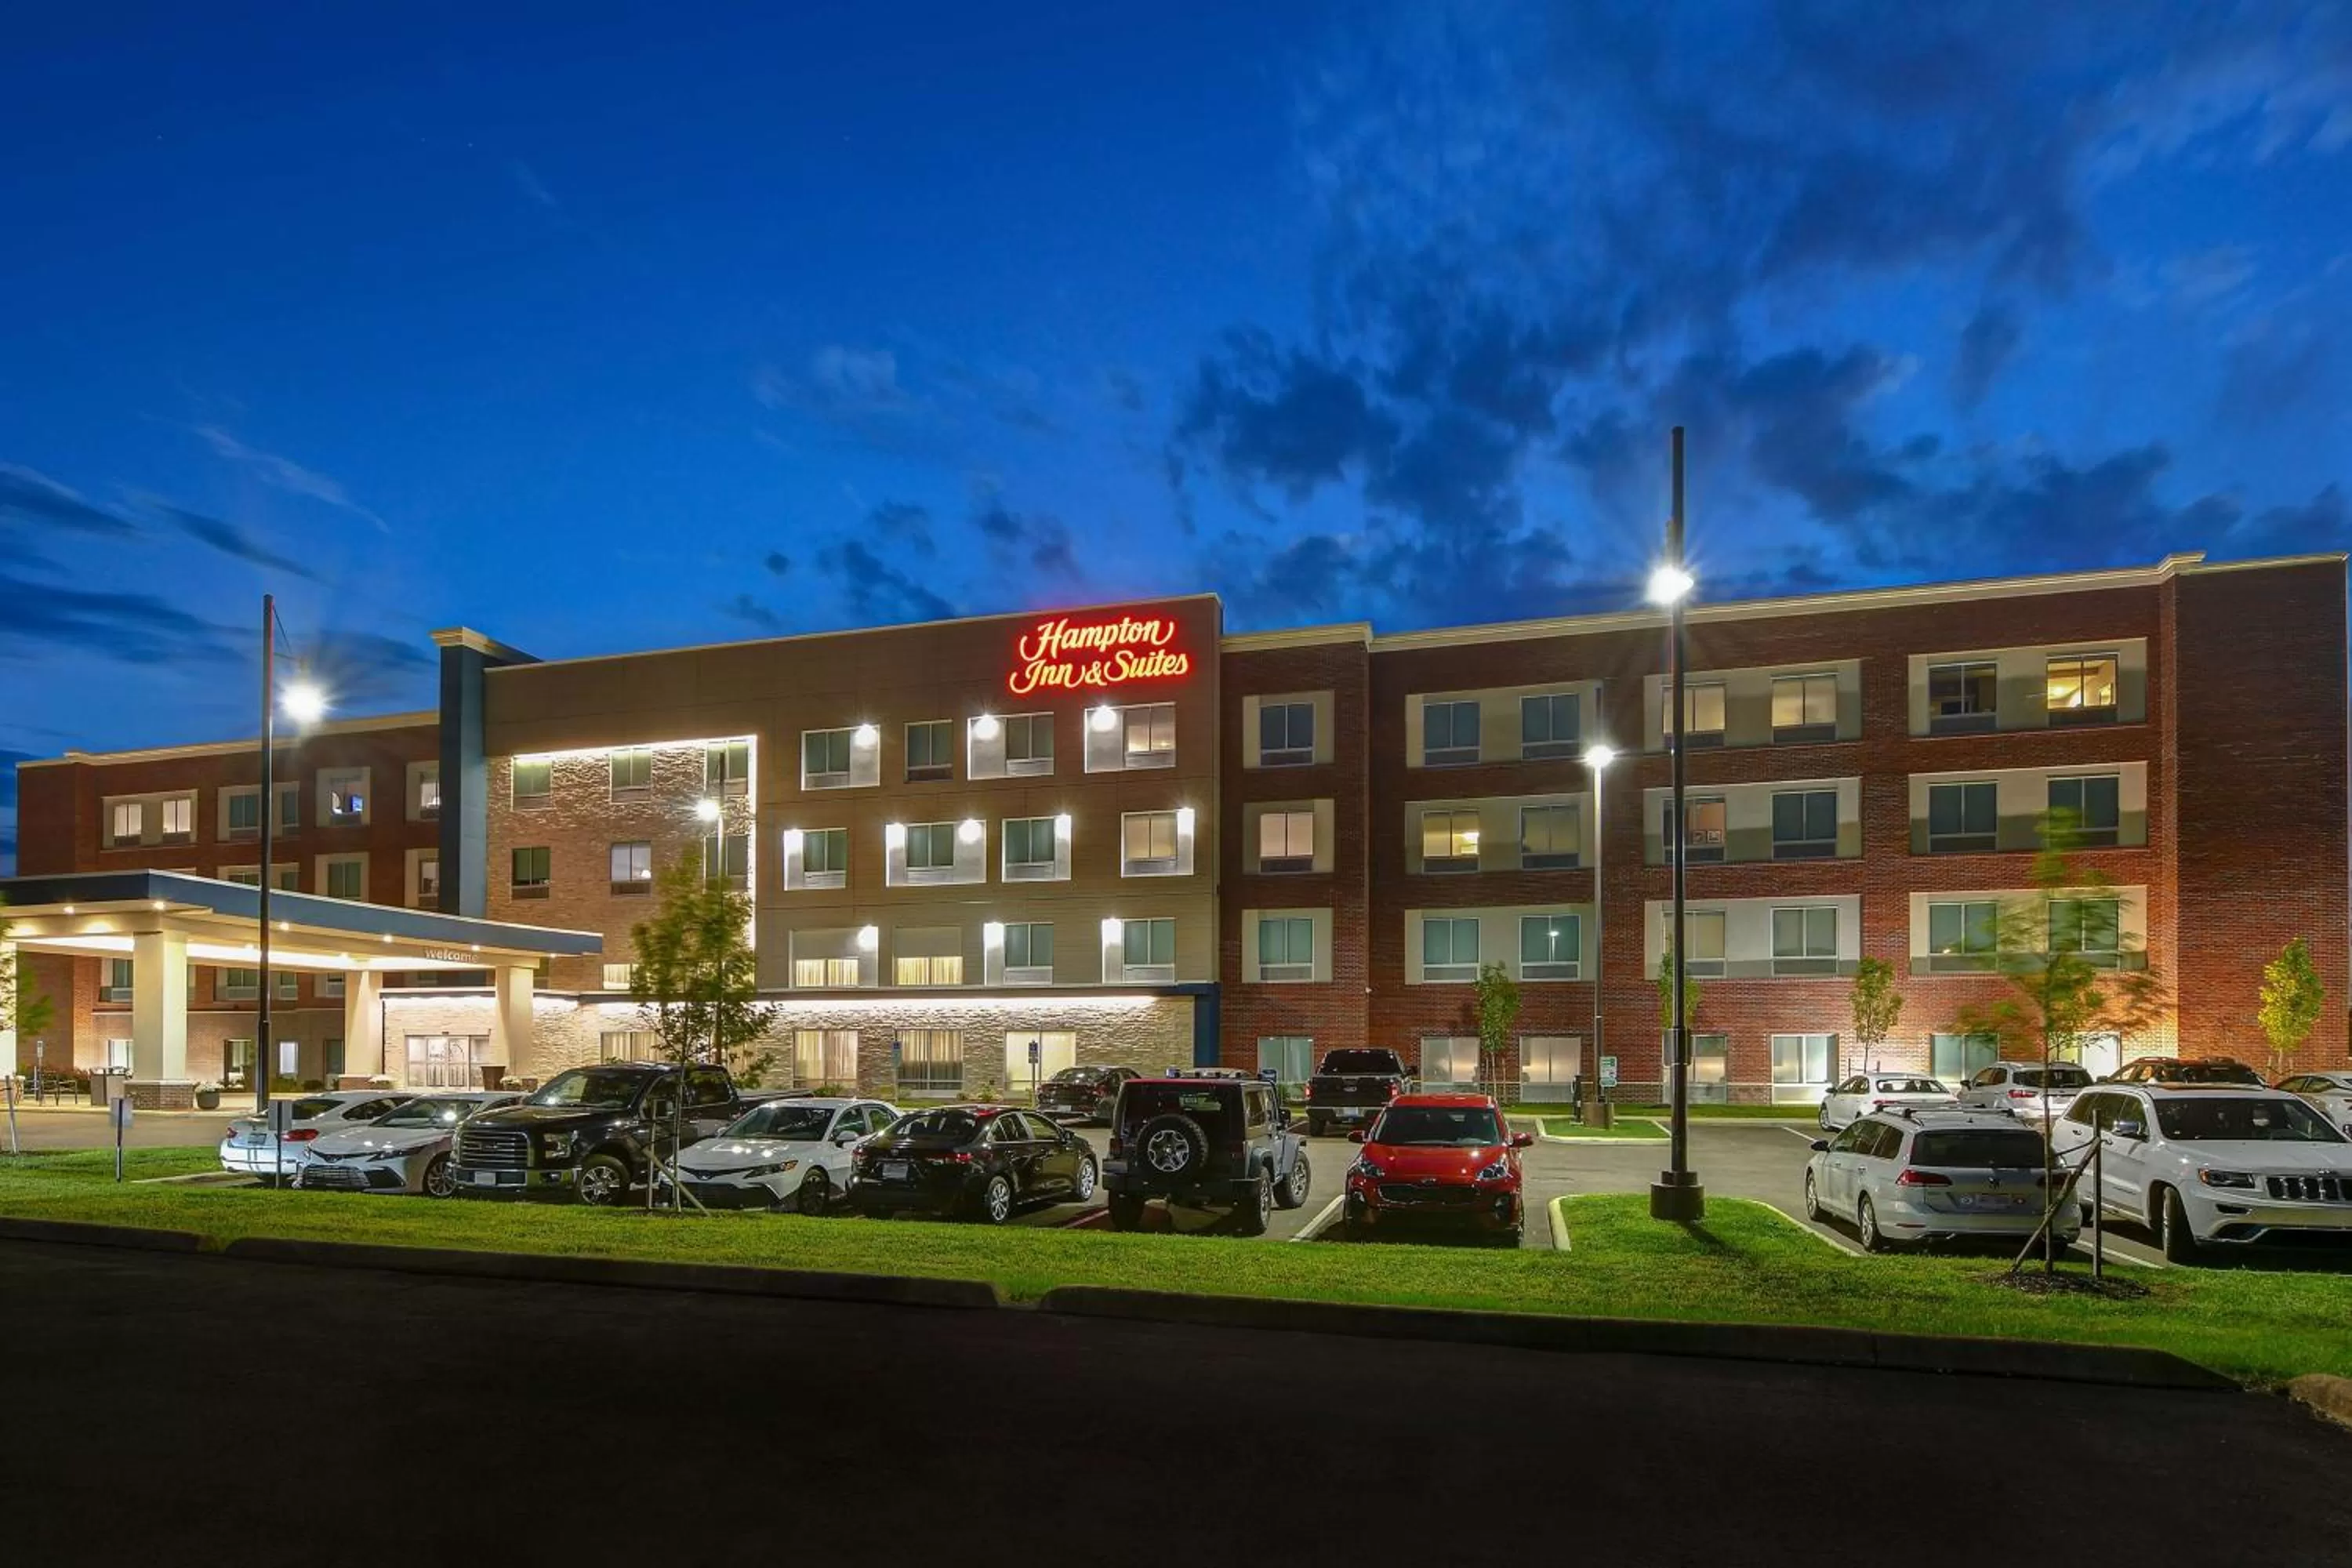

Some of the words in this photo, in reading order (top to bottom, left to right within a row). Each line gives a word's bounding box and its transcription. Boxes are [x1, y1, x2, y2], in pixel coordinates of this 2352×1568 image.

[1019, 617, 1174, 661] Hampton
[1009, 659, 1086, 694] Inn
[1084, 661, 1108, 686] &
[1104, 649, 1189, 682] Suites
[425, 947, 478, 963] welcome
